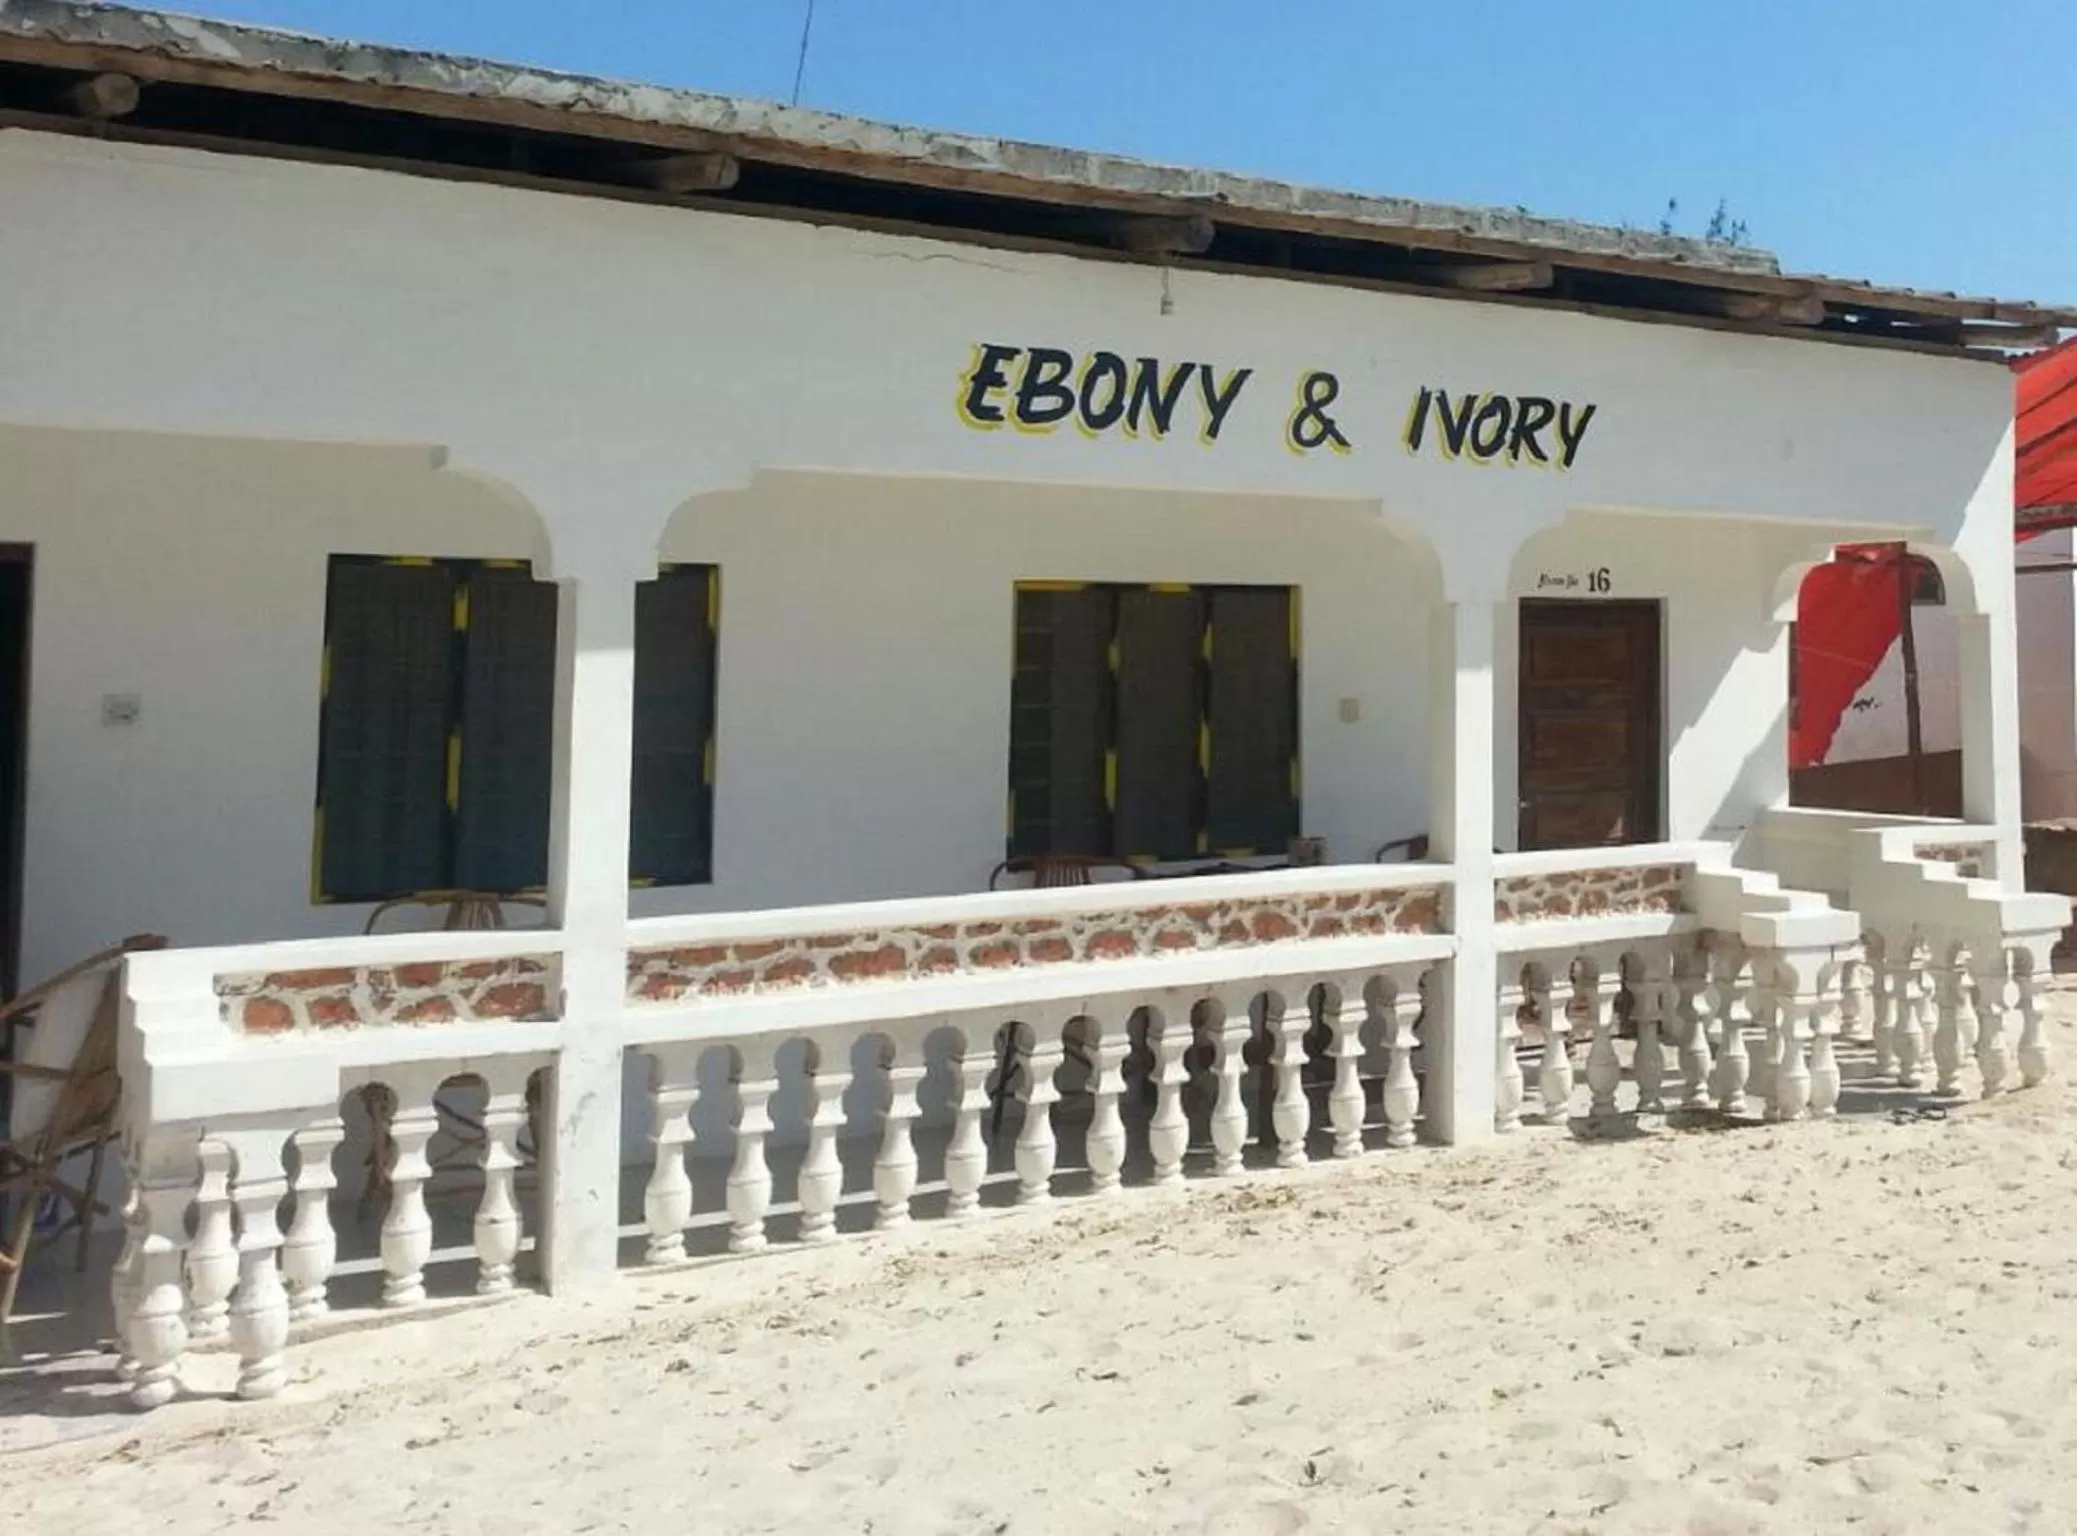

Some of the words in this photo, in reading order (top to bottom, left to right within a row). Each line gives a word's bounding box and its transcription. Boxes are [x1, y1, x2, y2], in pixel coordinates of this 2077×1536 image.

[957, 343, 1254, 446] EBONY
[1286, 371, 1352, 455] &
[1403, 385, 1597, 471] IVORY
[1587, 566, 1612, 593] 16
